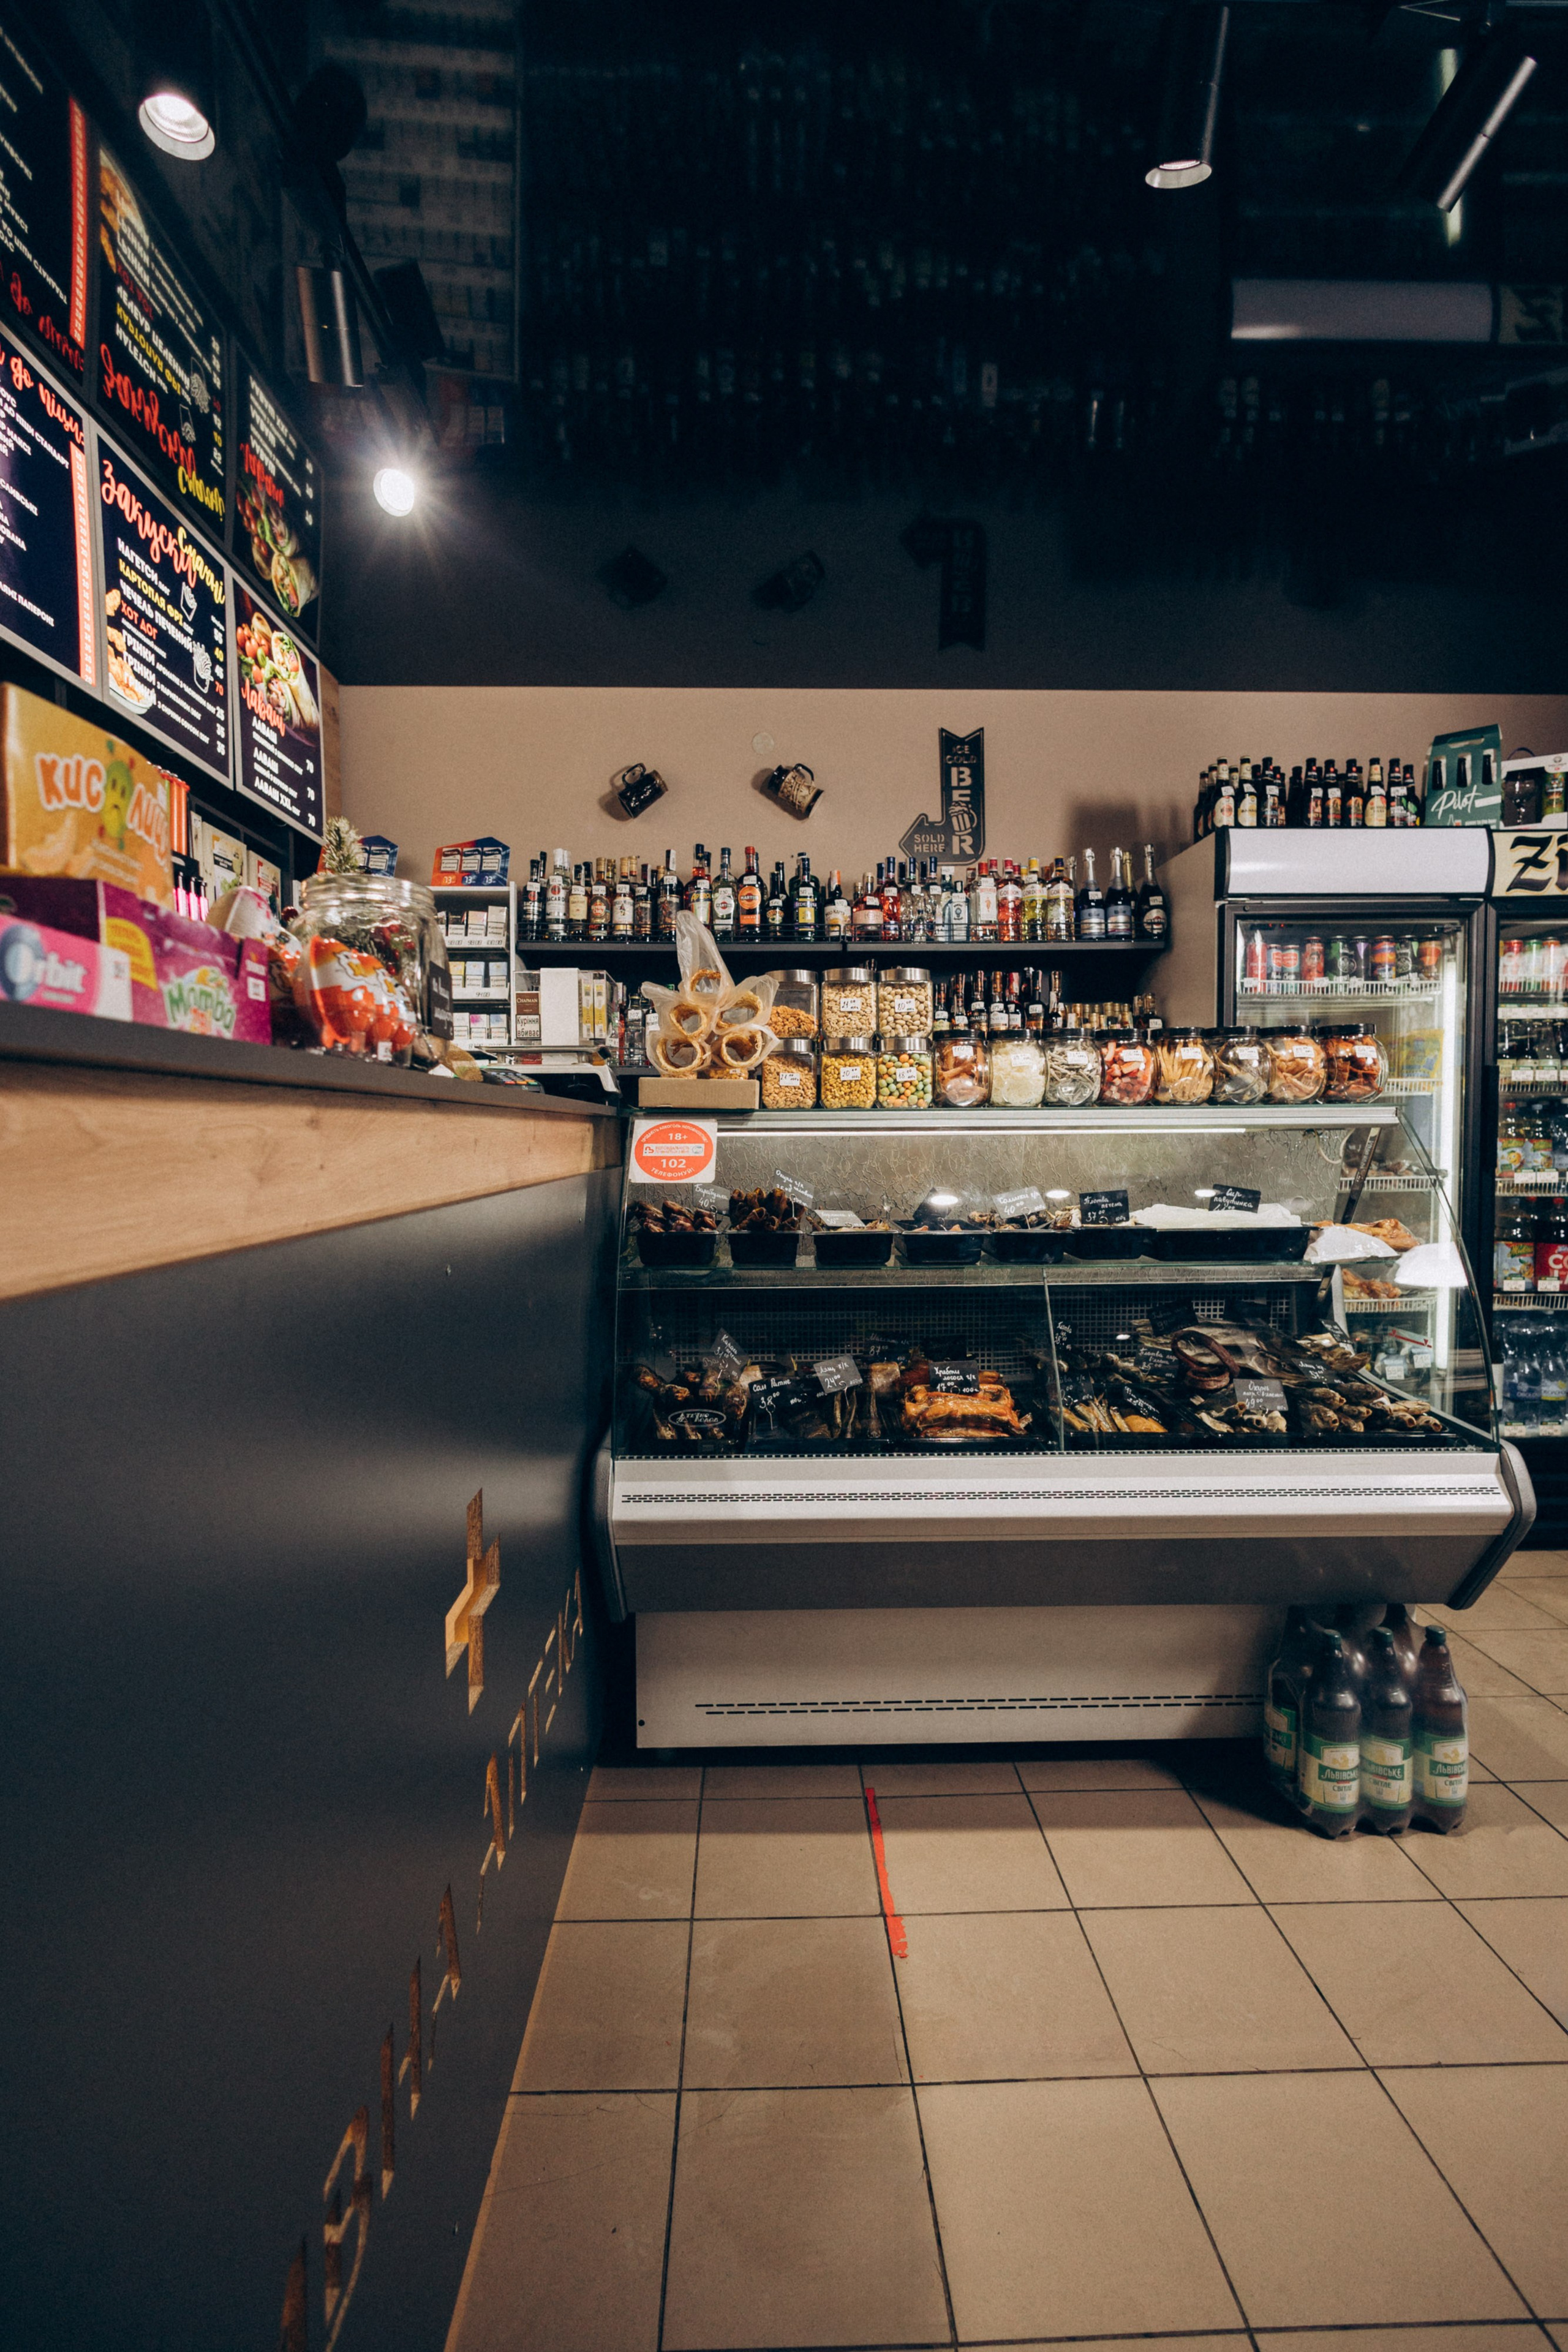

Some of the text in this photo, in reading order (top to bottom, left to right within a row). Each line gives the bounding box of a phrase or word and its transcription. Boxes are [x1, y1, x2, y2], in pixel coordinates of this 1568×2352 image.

[101, 459, 197, 589] Закуски
[117, 537, 159, 586] НАГЕТСИ
[177, 526, 225, 605] Смачні
[118, 559, 167, 611] КАРТОПЛЯ
[167, 604, 184, 627] ФРІ
[119, 579, 154, 619] ЧЕЧЕЛЬ
[154, 610, 194, 654] ПЕЧЕНИЙ
[121, 600, 139, 625] ХОТ
[139, 618, 158, 640] ДОГ
[123, 628, 156, 666] ГРІНКИ
[123, 651, 156, 686] ГРІНКИ
[215, 681, 224, 696] 70
[241, 677, 285, 737] Лаваш
[252, 715, 278, 745] ЛАВАШ
[952, 745, 970, 753] ICE
[253, 746, 279, 775] ЛАВАШ
[306, 758, 314, 774] 70
[946, 755, 977, 764] COLD
[254, 776, 280, 802] ЛАВАШ
[279, 793, 293, 812] XXL
[307, 786, 315, 802] 70
[1431, 785, 1483, 820] Pilot
[307, 813, 316, 827] 70
[914, 834, 945, 843] SOLD
[914, 843, 946, 853] HERE
[517, 1015, 539, 1027] Куріння
[517, 1028, 540, 1037] вбиває
[661, 1158, 687, 1168] 102
[1004, 1205, 1016, 1215] 40
[1213, 1196, 1254, 1208] павутинка
[1085, 1212, 1097, 1223] 37
[824, 1376, 837, 1389] 24
[936, 1382, 947, 1392] 17
